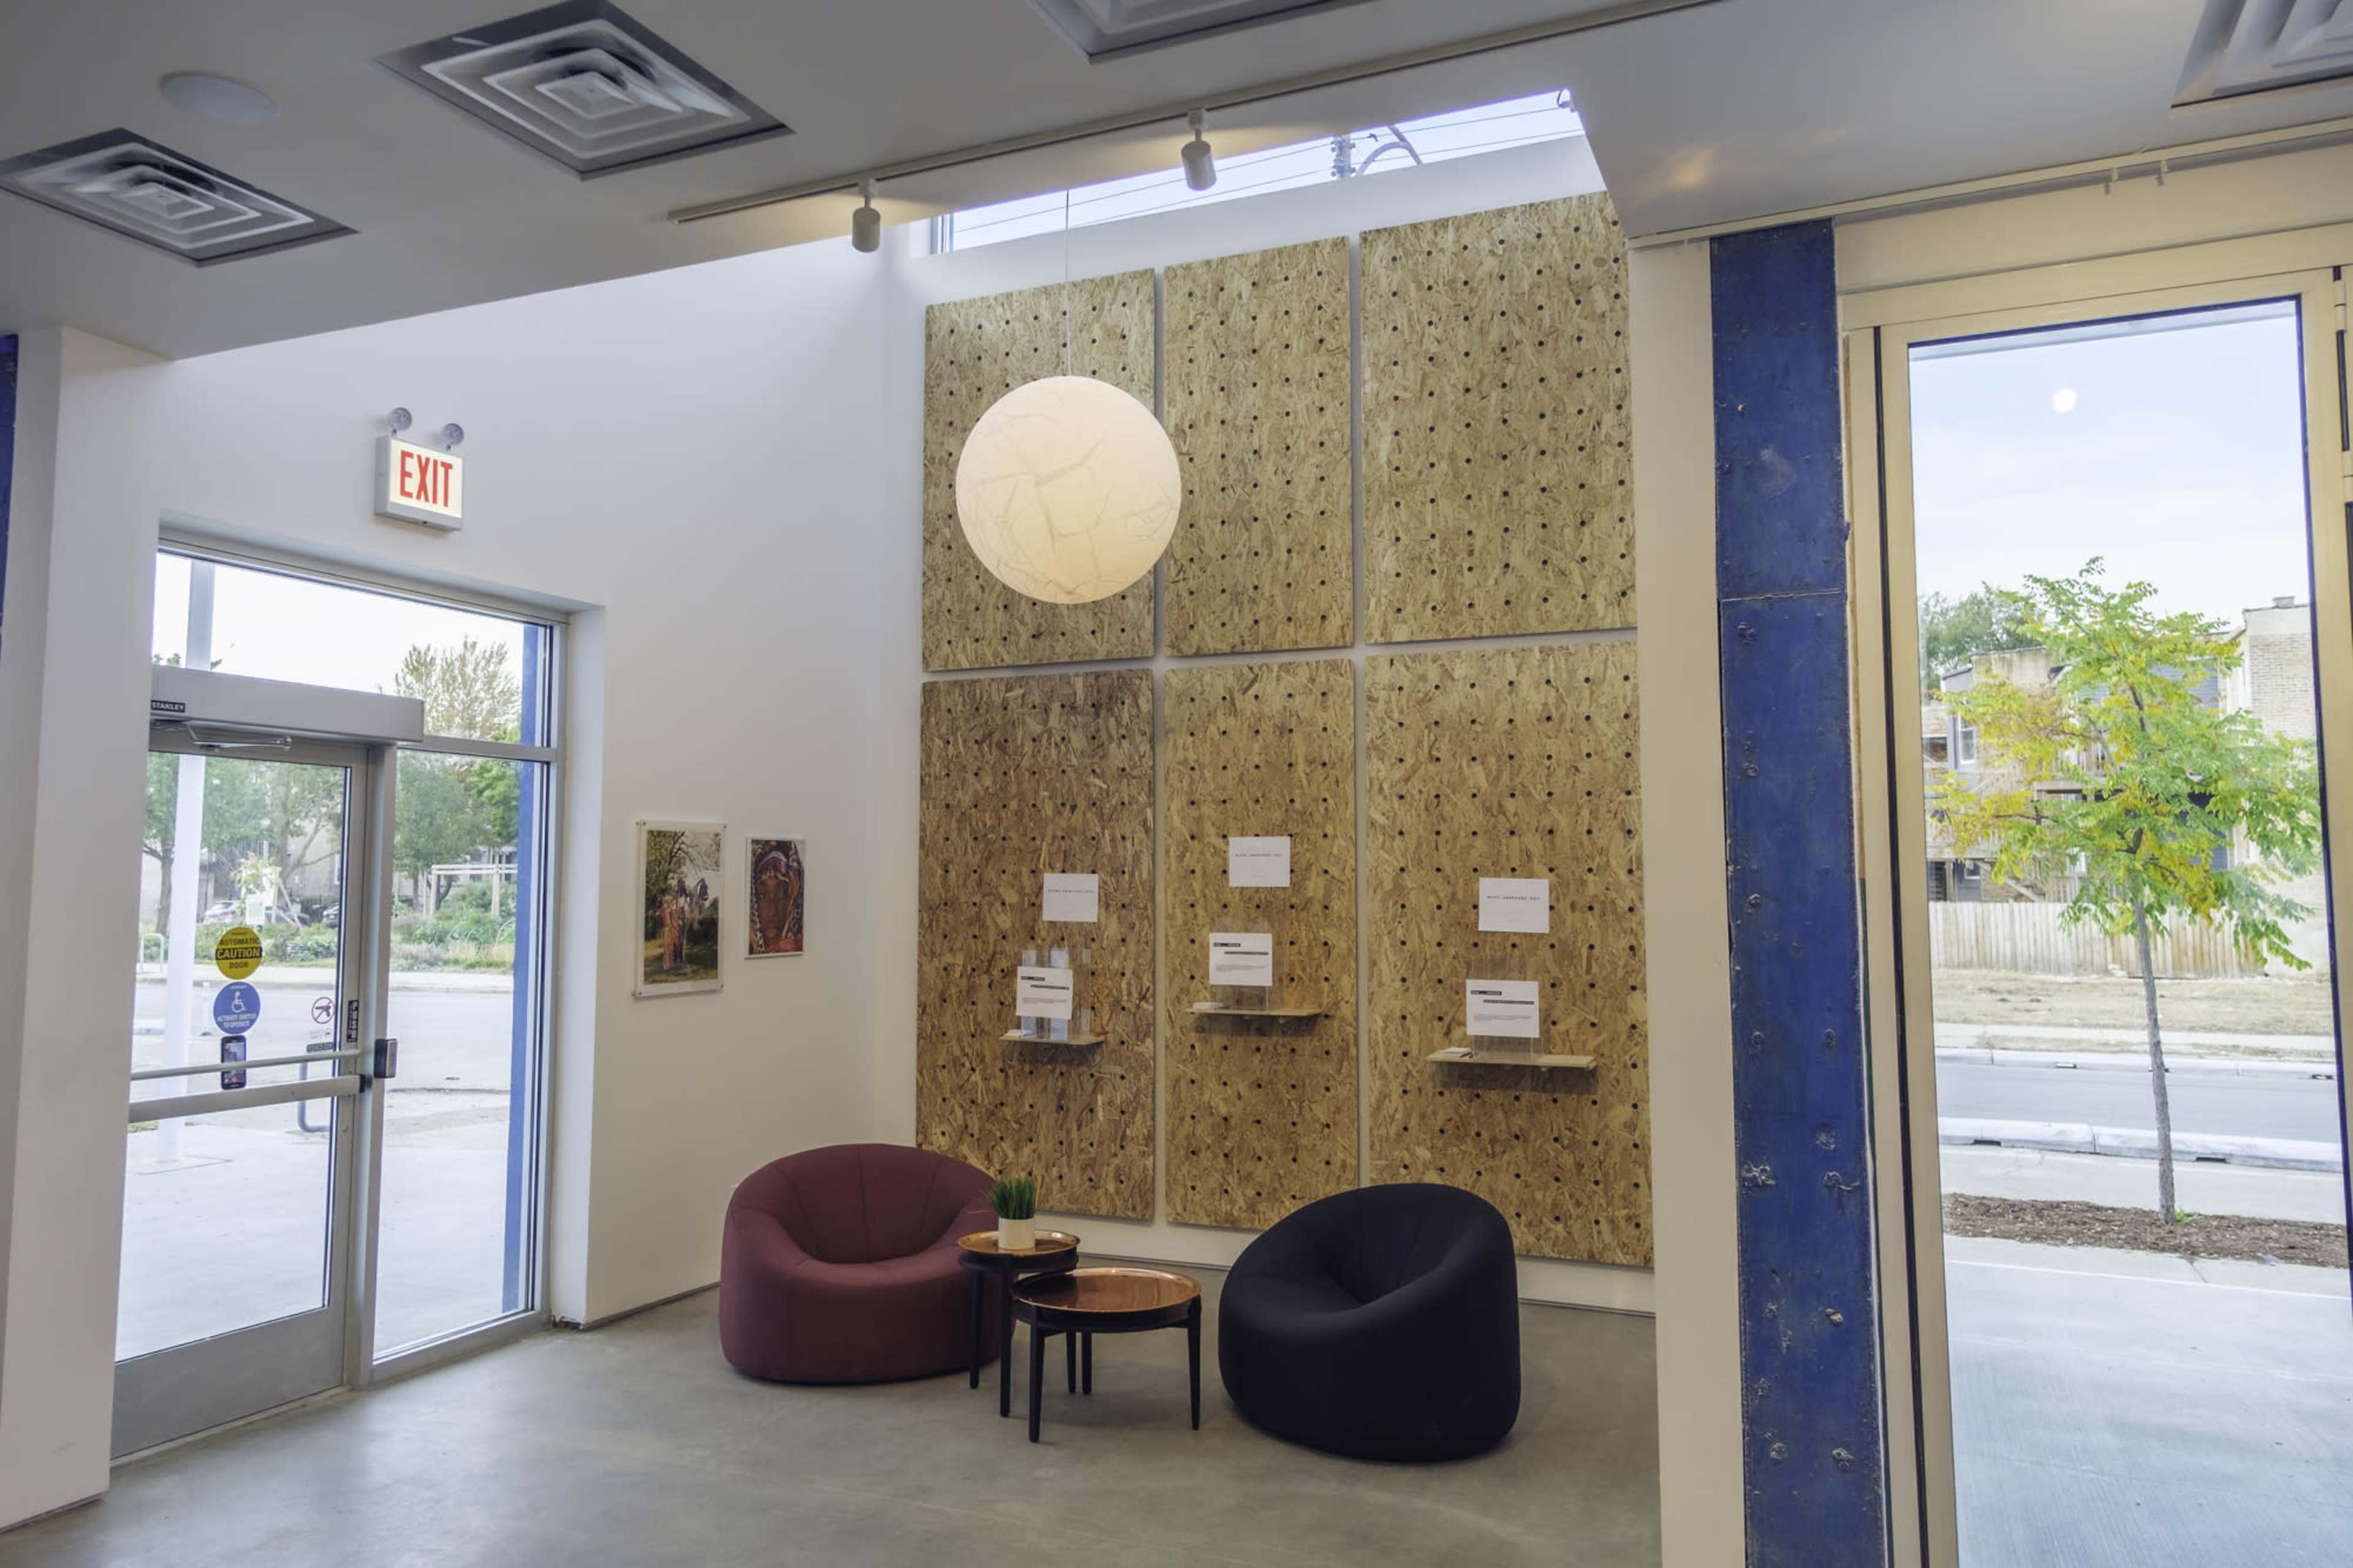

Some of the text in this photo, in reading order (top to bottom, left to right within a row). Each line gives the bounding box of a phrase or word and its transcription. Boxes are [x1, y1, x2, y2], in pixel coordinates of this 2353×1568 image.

[400, 450, 453, 507] EXIT
[152, 702, 184, 711] STANLEY
[216, 948, 261, 959] CAUTION
